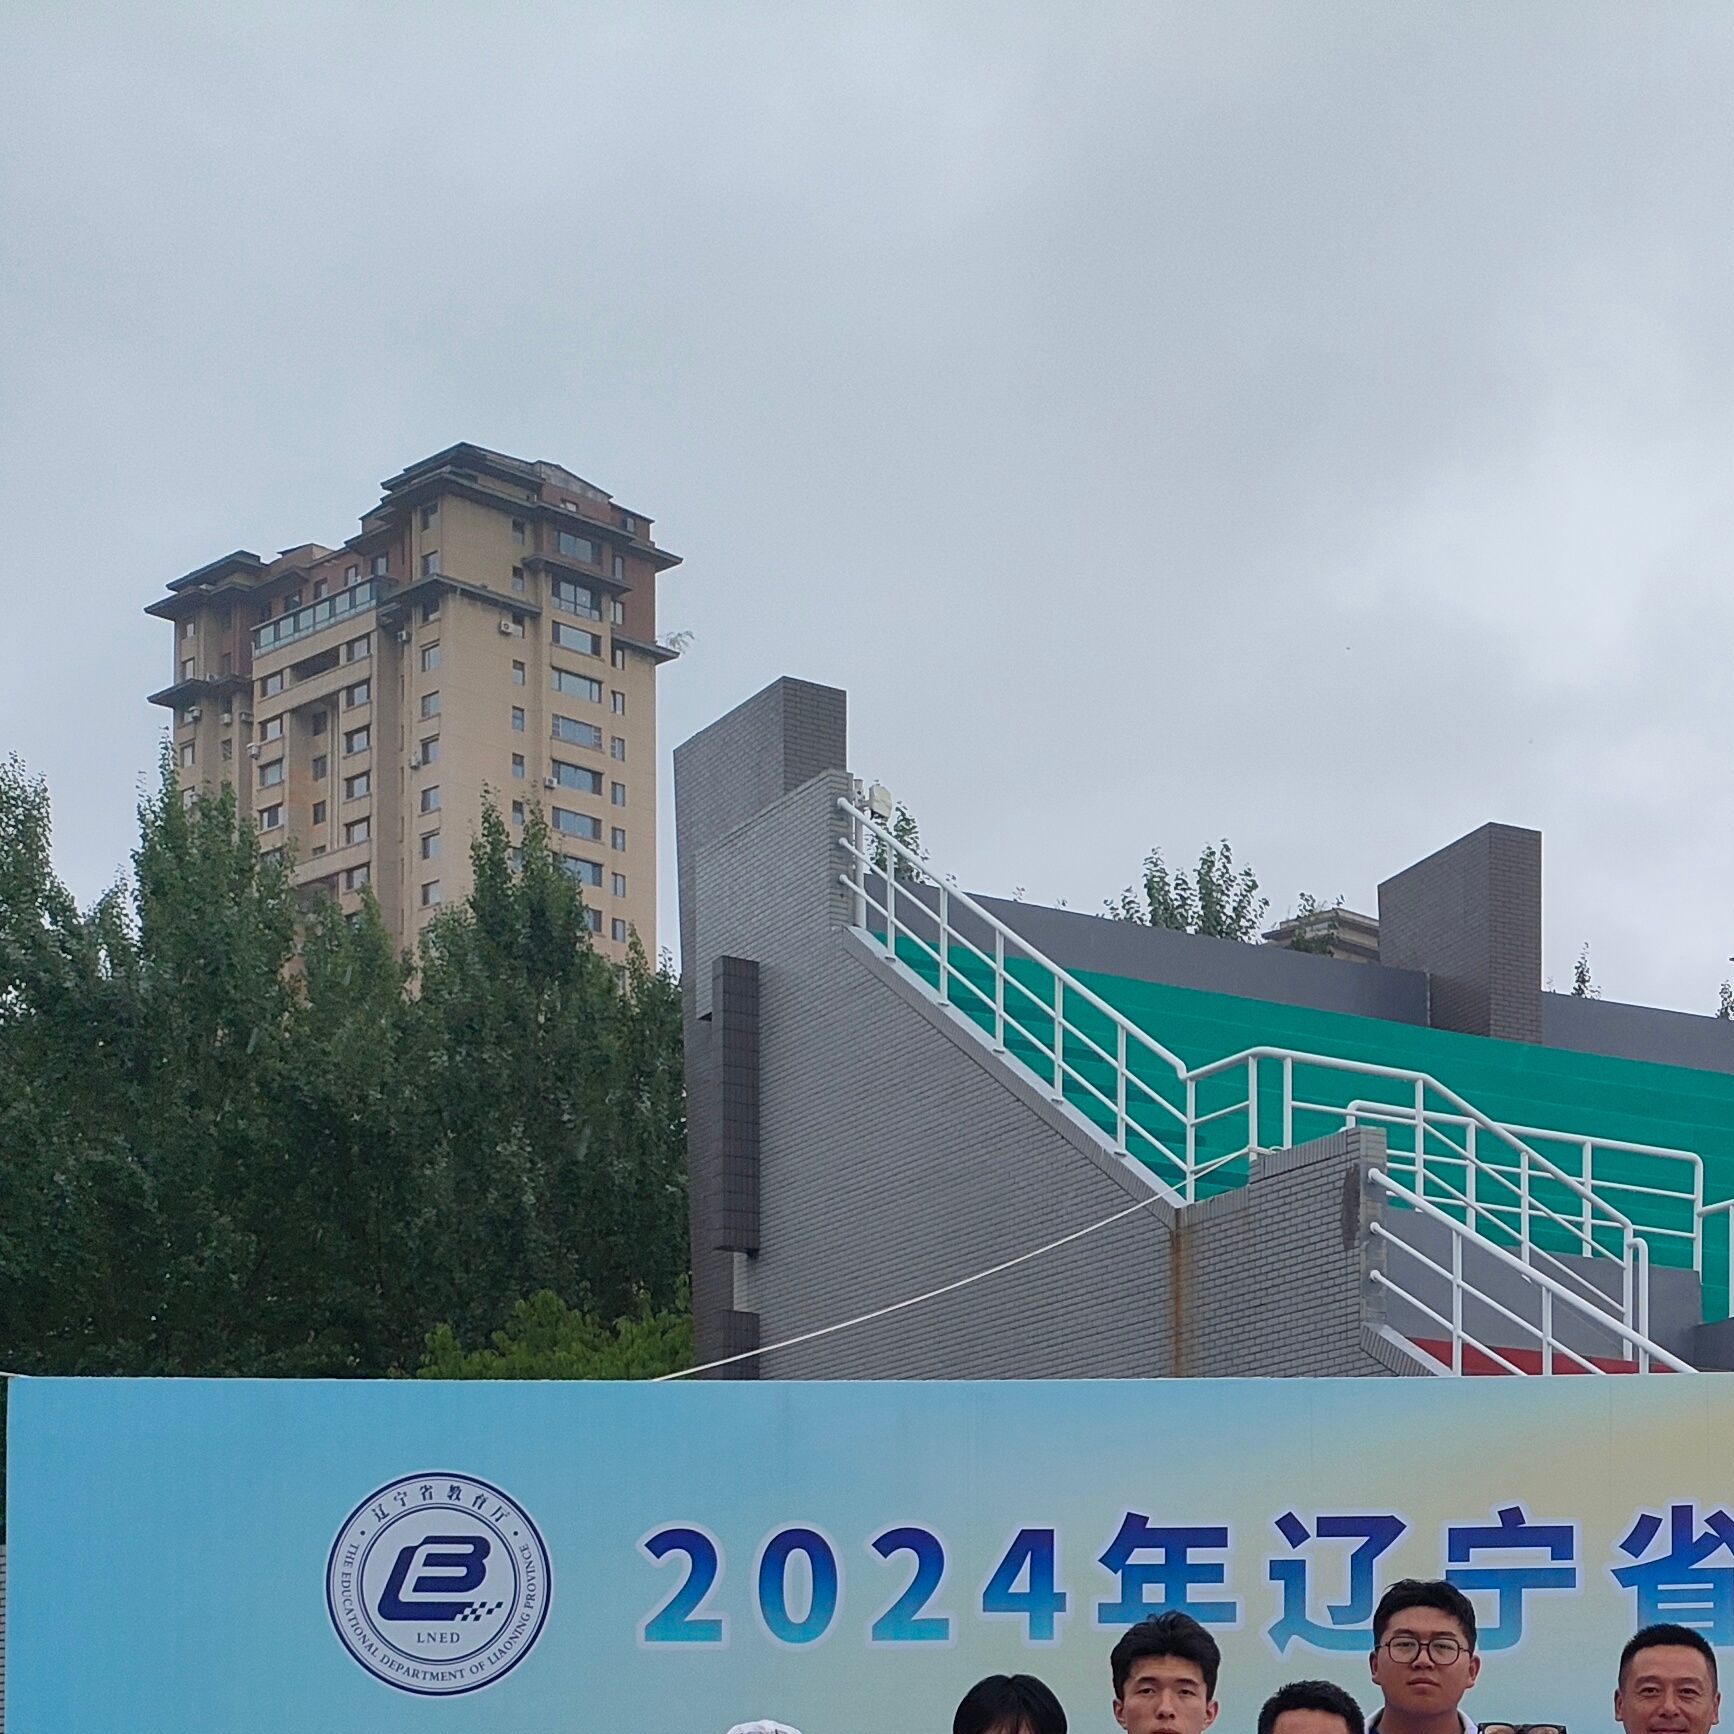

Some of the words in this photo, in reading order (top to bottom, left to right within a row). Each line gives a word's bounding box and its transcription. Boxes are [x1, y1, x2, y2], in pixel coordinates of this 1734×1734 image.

[372, 1484, 511, 1523] 辽宁省教育厅
[343, 1543, 360, 1567] THE
[519, 1543, 537, 1610] PROVINCE
[341, 1571, 379, 1658] EDUCATIONAL
[417, 1631, 460, 1644] LNED
[488, 1612, 531, 1666] LIAONING
[379, 1653, 465, 1682] DEPARTMENT
[469, 1660, 486, 1675] OF
